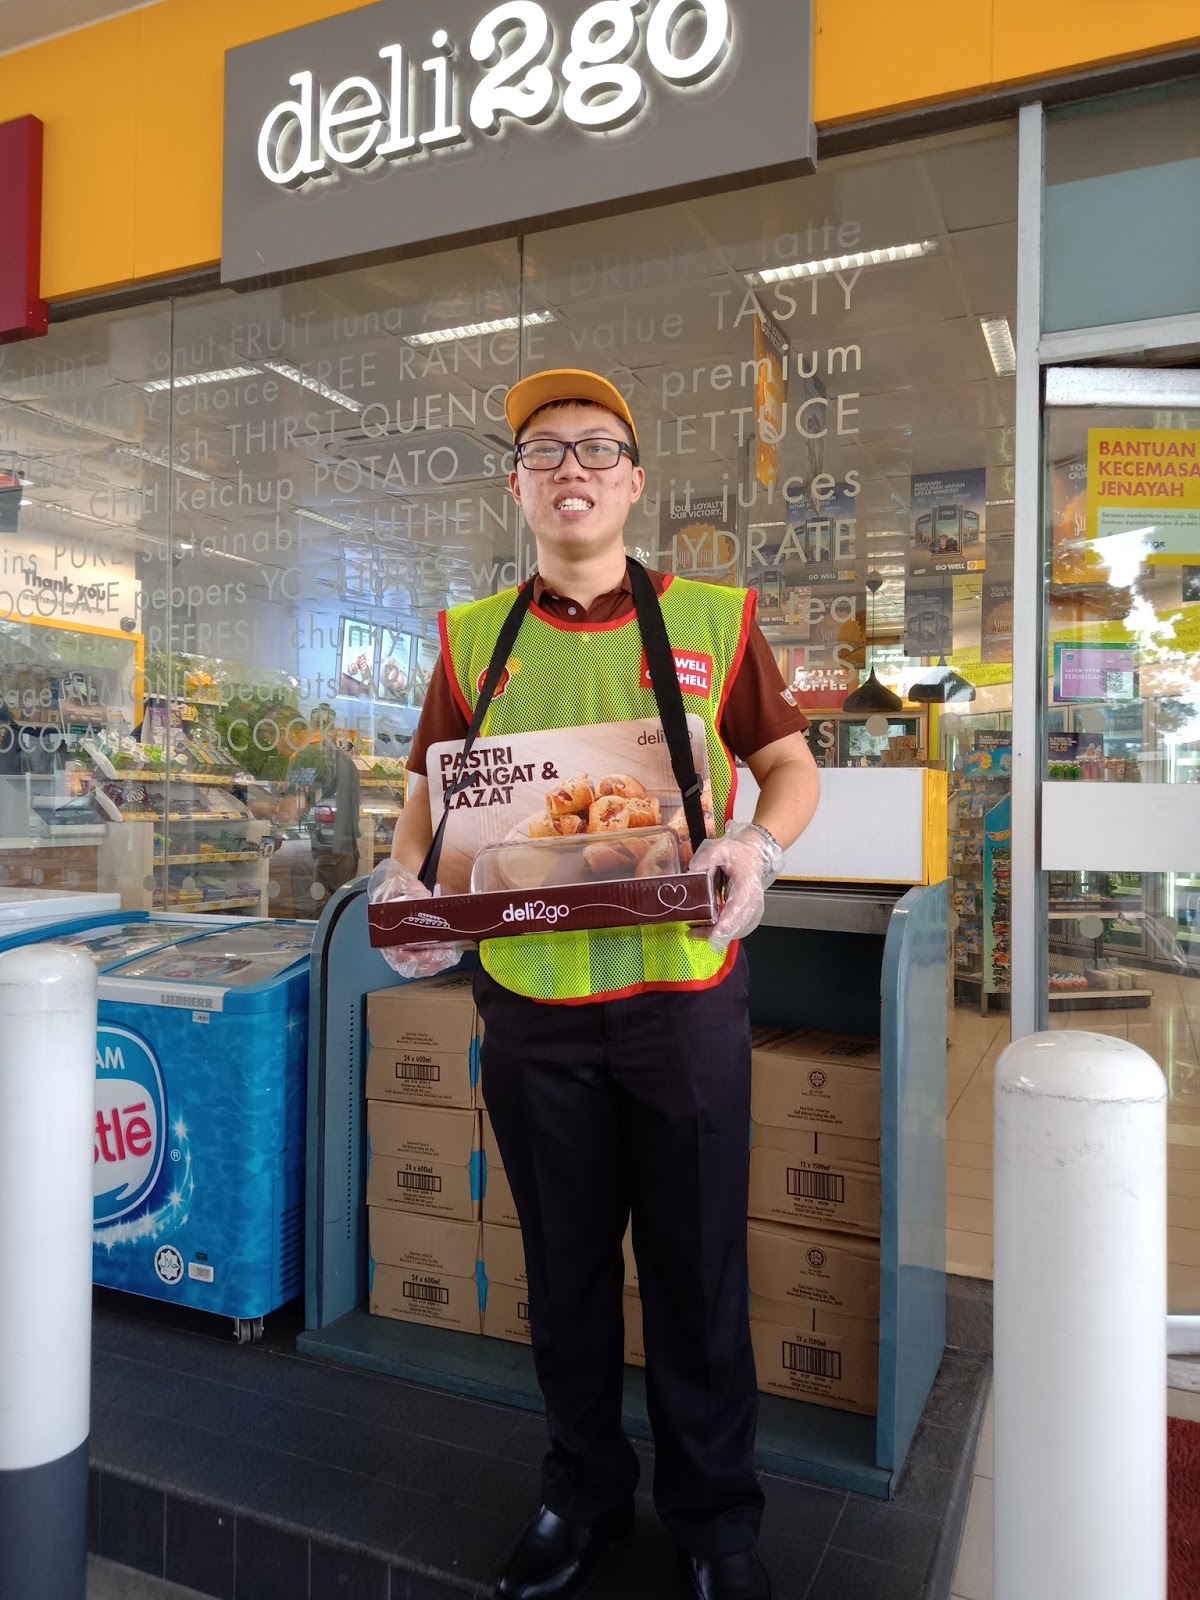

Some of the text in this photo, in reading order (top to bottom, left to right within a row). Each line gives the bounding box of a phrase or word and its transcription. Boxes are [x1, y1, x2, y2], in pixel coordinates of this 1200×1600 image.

[257, 0, 731, 188] deli2go
[230, 311, 317, 355] FRUIT
[332, 307, 402, 340] tuna
[761, 218, 862, 263] latte
[176, 379, 280, 416] choice
[300, 352, 378, 396] FREE
[400, 331, 545, 382] RANGE
[568, 303, 685, 354] value
[709, 267, 862, 331] TASTY
[226, 409, 343, 456] THIRST
[662, 343, 862, 410] premium
[176, 470, 294, 513] ketchup
[314, 446, 459, 497] POTATO
[656, 392, 860, 457] LETTUCE
[1099, 441, 1196, 457] BANTUAN
[1099, 461, 1200, 477] KECEMASA
[1098, 481, 1184, 497] JENAYAH
[670, 511, 688, 520] OUR
[693, 501, 724, 511] LOYALTY
[54, 534, 124, 571] PURE
[722, 468, 861, 523] juices
[135, 580, 248, 620] peppers
[651, 518, 857, 573] HYDRATE
[935, 563, 966, 571] GO WELL
[23, 567, 106, 601] Thank you
[289, 610, 404, 657] chunky
[787, 591, 857, 625] tea
[674, 656, 707, 673] WELL
[220, 671, 337, 713] peanuts
[676, 672, 708, 690] SHELL
[440, 746, 512, 771] PASTRI
[441, 761, 560, 790] HANGAT &
[502, 901, 569, 924] deli2go
[160, 993, 213, 1009] LIEBHERR
[403, 1054, 411, 1062] 24
[416, 1055, 432, 1064] 600ml
[405, 1163, 412, 1172] 24
[417, 1165, 433, 1173] 600ml
[411, 1274, 418, 1282] 24
[424, 1276, 440, 1285] 600ml
